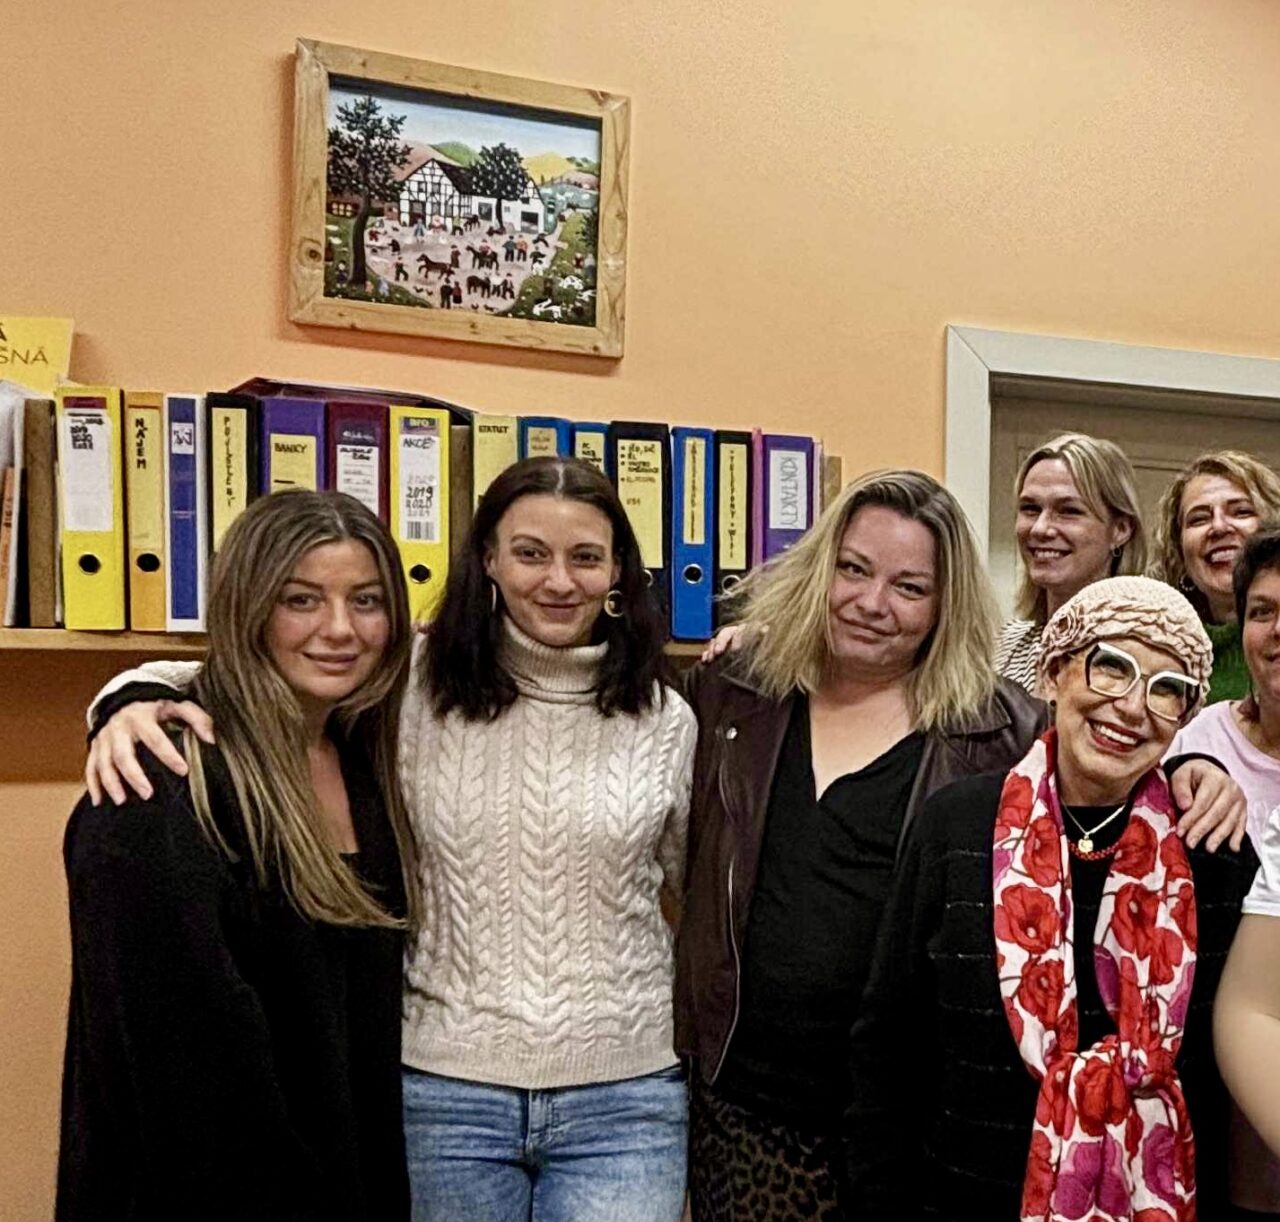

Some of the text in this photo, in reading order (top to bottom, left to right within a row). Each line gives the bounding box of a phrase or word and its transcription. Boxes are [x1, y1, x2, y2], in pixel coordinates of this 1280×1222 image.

[274, 443, 308, 454] BANKY
[406, 486, 434, 500] 2019
[779, 456, 800, 528] KONTAKTY
